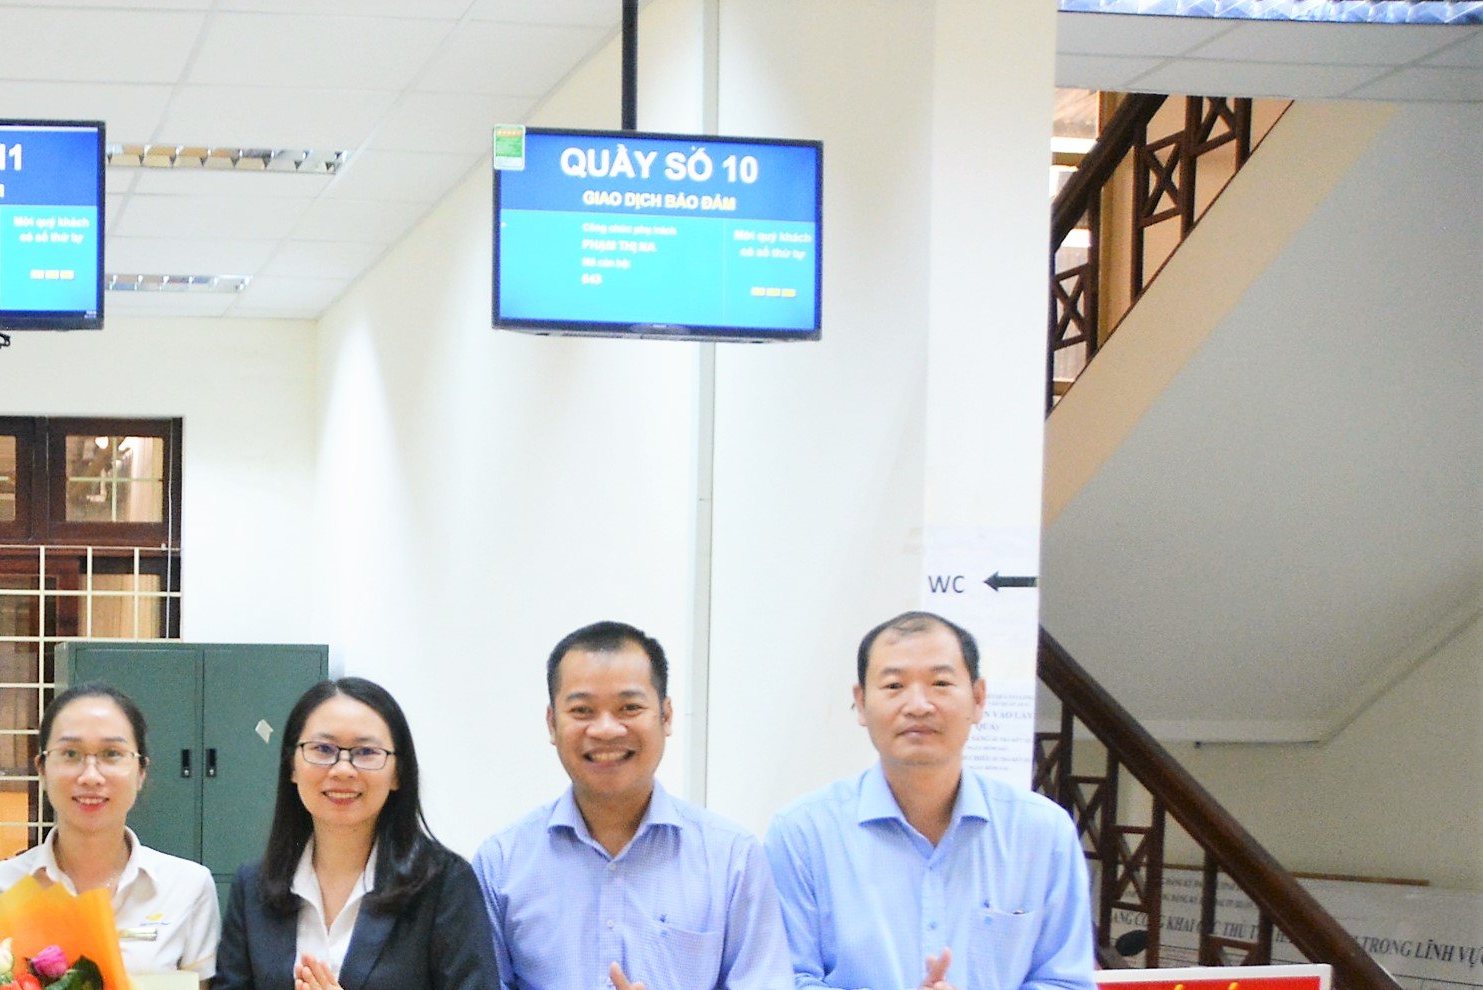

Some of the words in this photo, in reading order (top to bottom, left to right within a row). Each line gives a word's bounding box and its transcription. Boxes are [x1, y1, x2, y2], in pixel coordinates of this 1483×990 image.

[560, 143, 657, 178] QUẦY
[664, 146, 713, 182] SỐ
[722, 154, 759, 184] 10
[582, 190, 622, 206] GIAO
[624, 191, 662, 210] DỊCH
[928, 575, 965, 593] WC
[1363, 935, 1411, 958] TRONG
[1415, 939, 1454, 961] LĨNH
